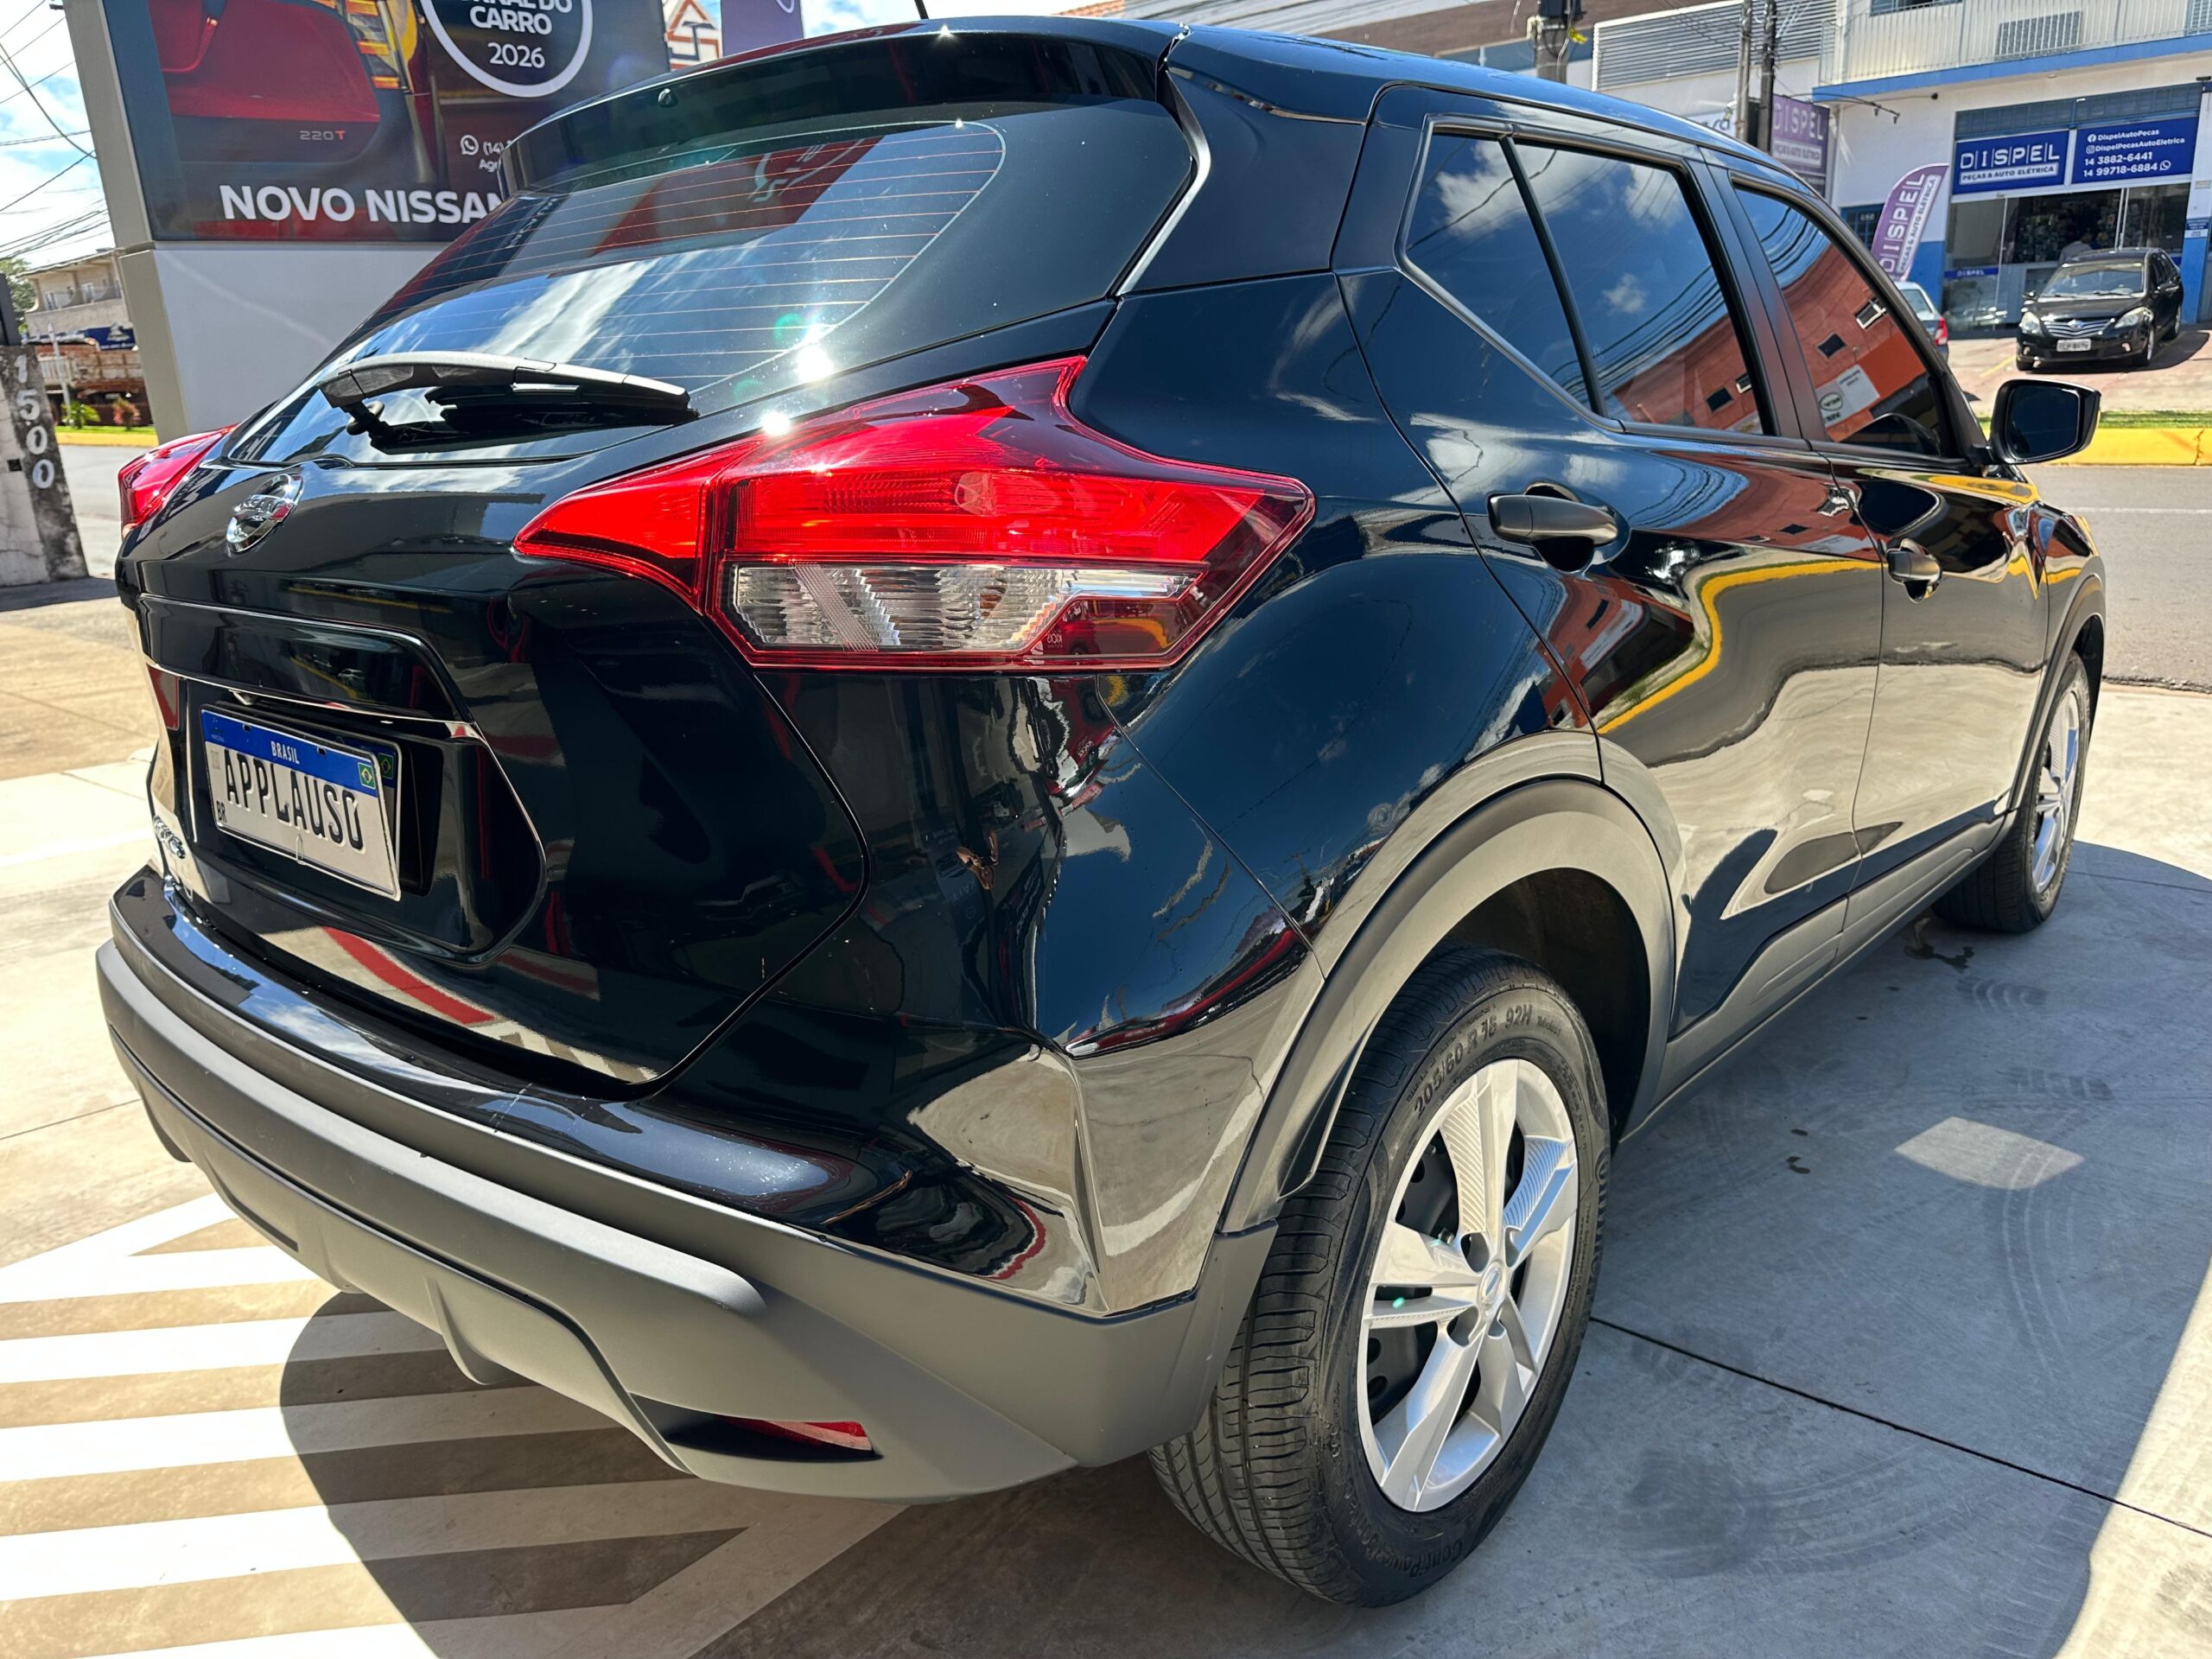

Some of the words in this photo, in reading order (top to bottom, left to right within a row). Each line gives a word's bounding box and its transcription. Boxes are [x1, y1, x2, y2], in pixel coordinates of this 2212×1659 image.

[469, 5, 552, 35] CARRO
[487, 42, 545, 68] 2026
[300, 130, 345, 141] 220T
[2098, 130, 2159, 141] DispelAutoPecas
[1960, 143, 2060, 169] DISPEL
[2097, 151, 2152, 164] 3882-6441
[2096, 162, 2158, 176] 99718-6884
[219, 185, 355, 222] NOVO
[1878, 173, 1925, 272] DISPEL
[14, 354, 54, 489] 1500
[270, 741, 300, 765] BRASIL
[216, 800, 227, 823] BR
[224, 748, 365, 853] APPLAUSO
[1504, 1004, 1533, 1029] 92H
